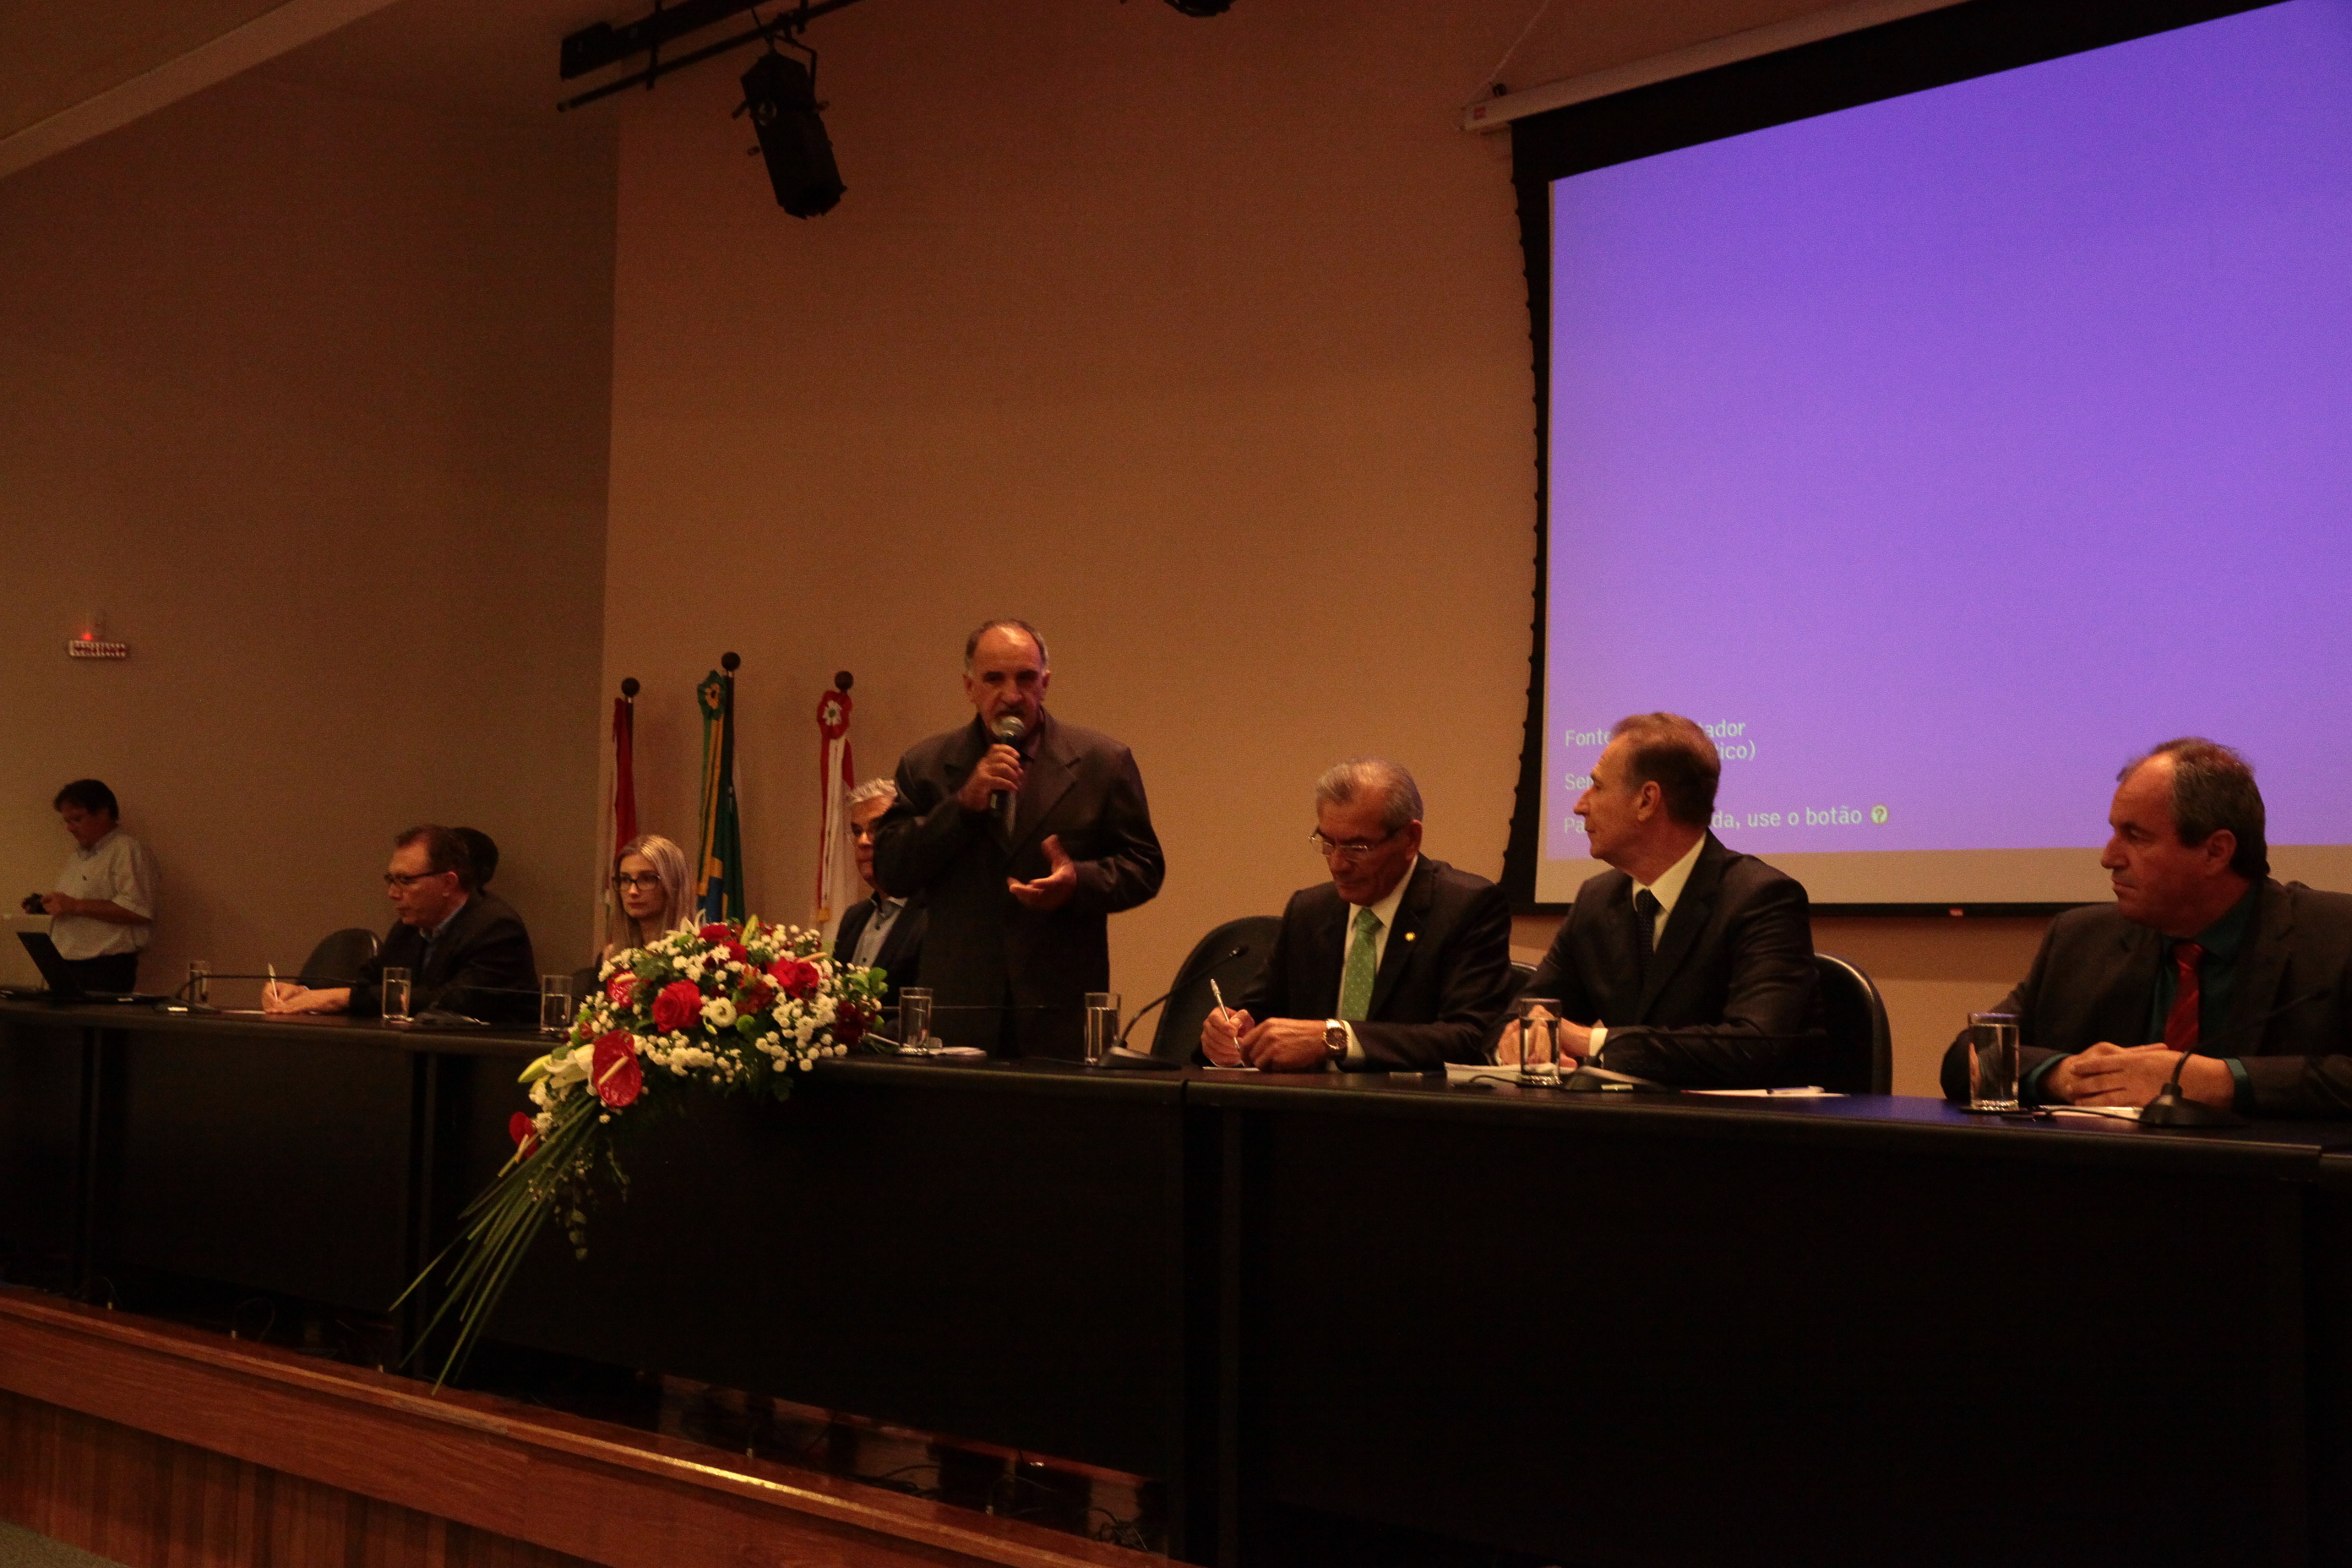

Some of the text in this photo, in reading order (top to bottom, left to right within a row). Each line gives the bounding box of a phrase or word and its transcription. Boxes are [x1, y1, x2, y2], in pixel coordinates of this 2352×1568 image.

[1747, 812, 1781, 827] use
[1787, 812, 1799, 825] o
[1805, 806, 1863, 825] botão
